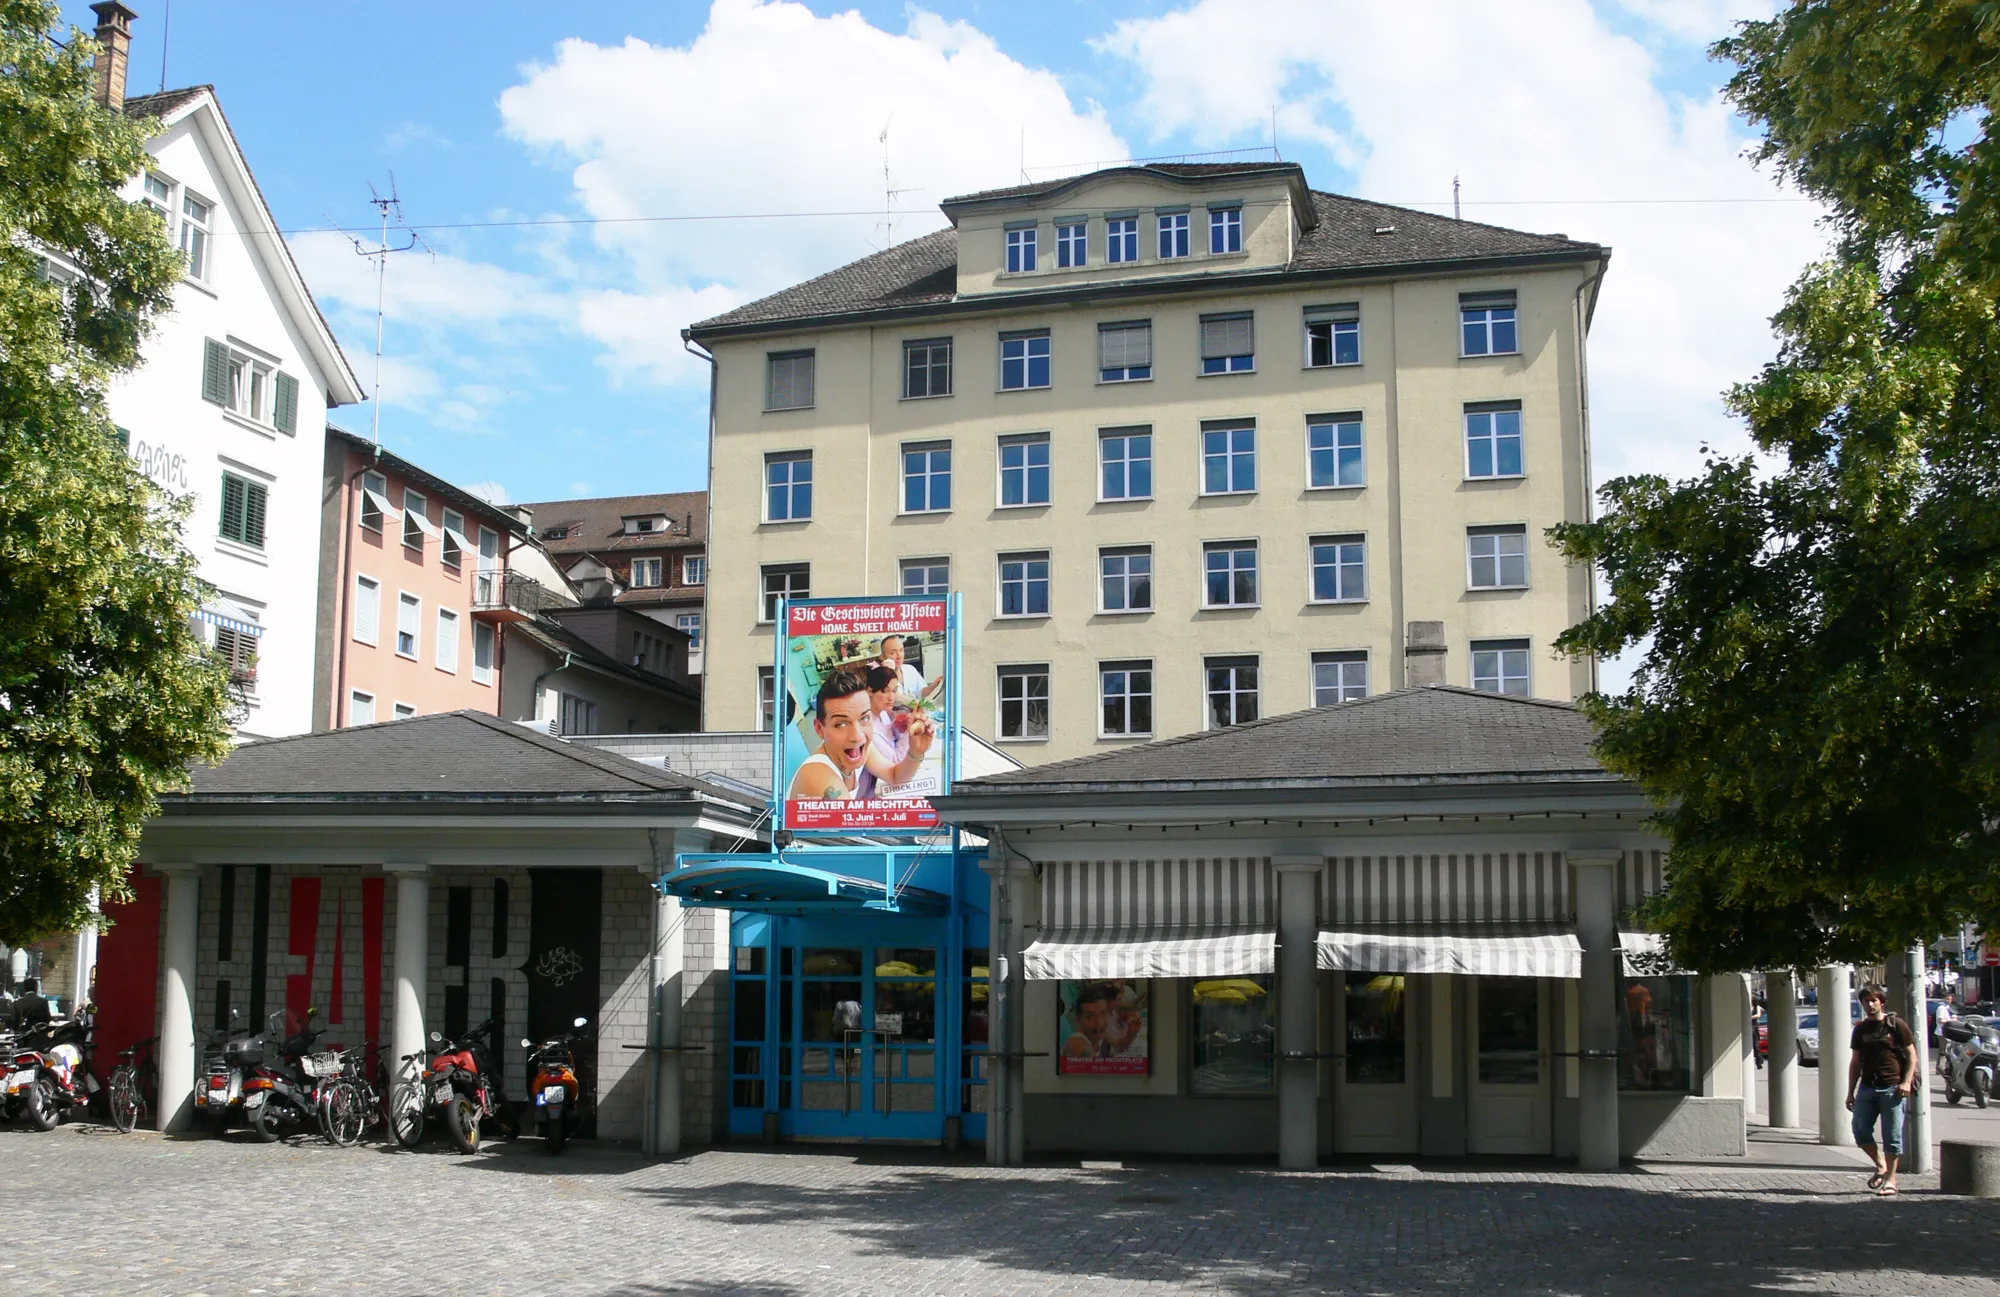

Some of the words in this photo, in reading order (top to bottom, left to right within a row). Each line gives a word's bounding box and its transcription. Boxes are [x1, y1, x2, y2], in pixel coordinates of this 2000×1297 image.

[793, 607, 817, 622] Die
[820, 606, 896, 621] Geschwister
[899, 604, 941, 621] Pfister
[853, 621, 885, 633] SWEET
[884, 781, 933, 794] SHOCKING!
[797, 801, 845, 810] THEATER
[847, 801, 864, 809] AM
[868, 801, 932, 809] HECHTPLAT
[842, 813, 854, 822] 13.
[856, 813, 873, 822] Juni
[883, 813, 890, 821] 1.
[892, 812, 906, 821] Juli
